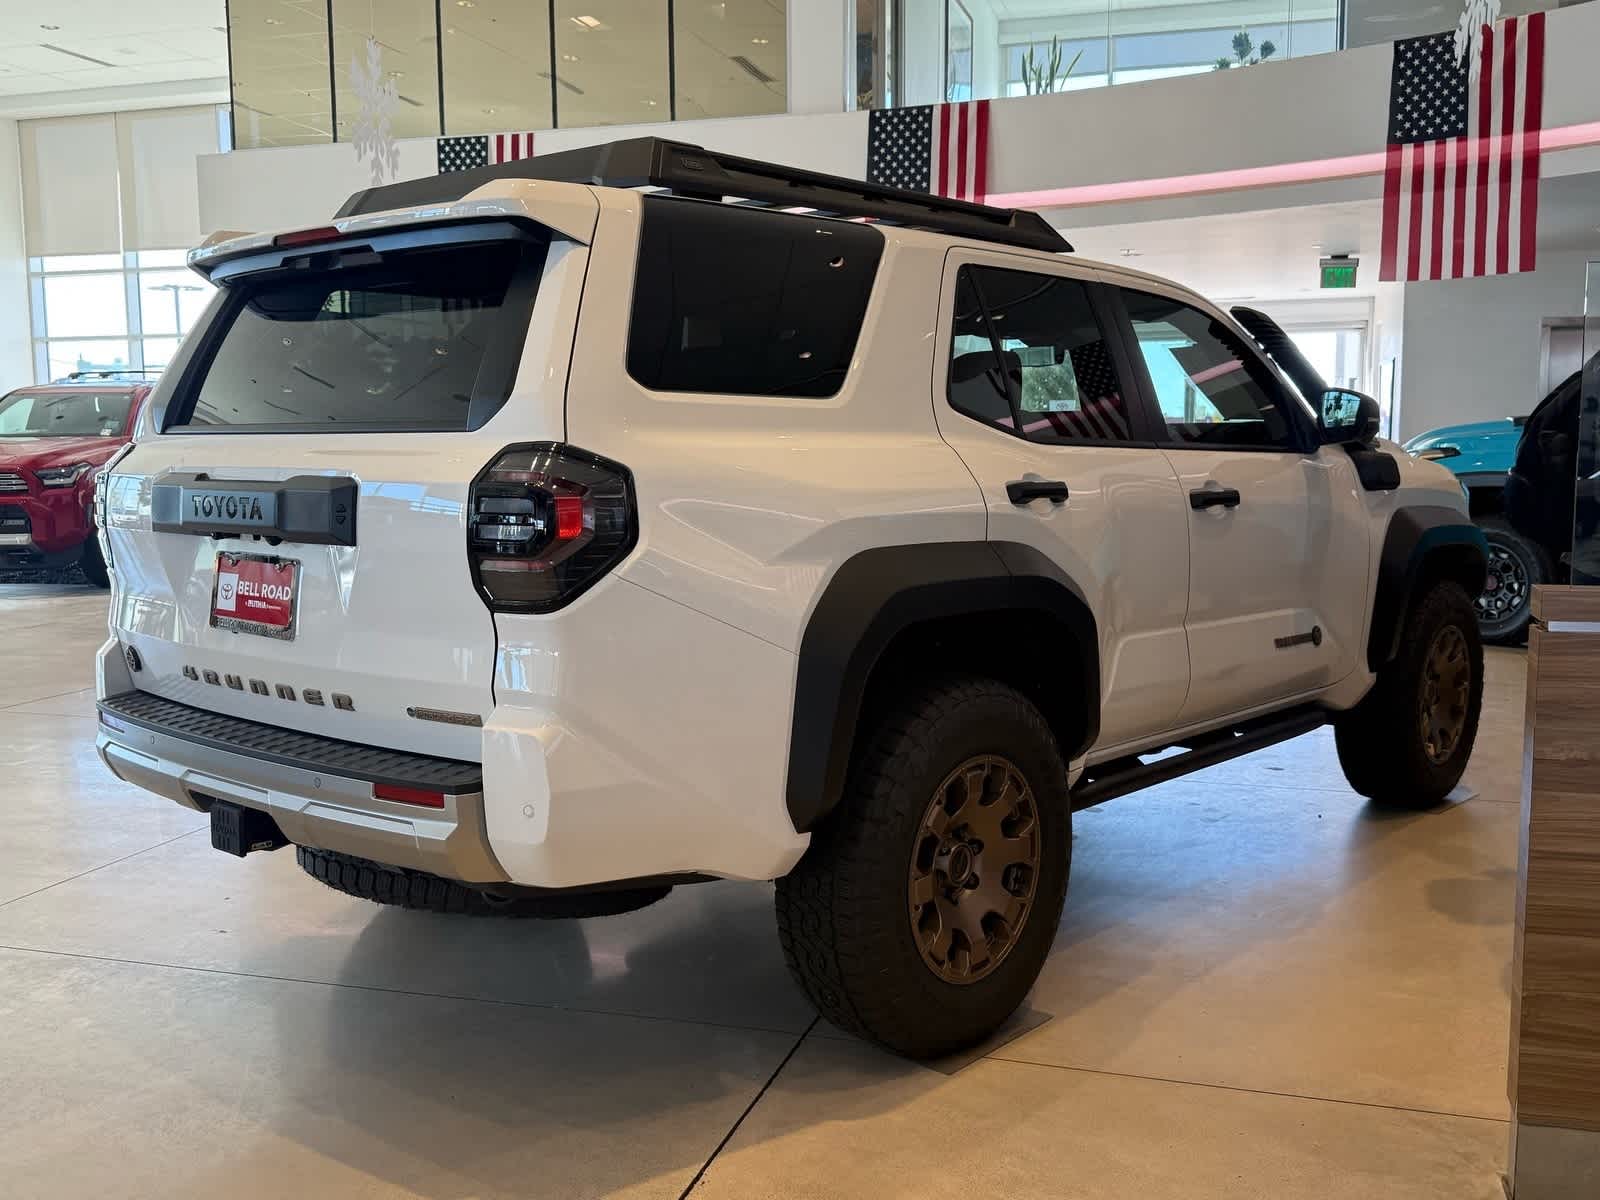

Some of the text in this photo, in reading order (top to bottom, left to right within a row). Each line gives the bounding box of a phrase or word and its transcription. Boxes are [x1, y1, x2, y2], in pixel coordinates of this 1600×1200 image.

[192, 495, 262, 520] TOYOTA
[238, 581, 291, 600] BELL ROAD
